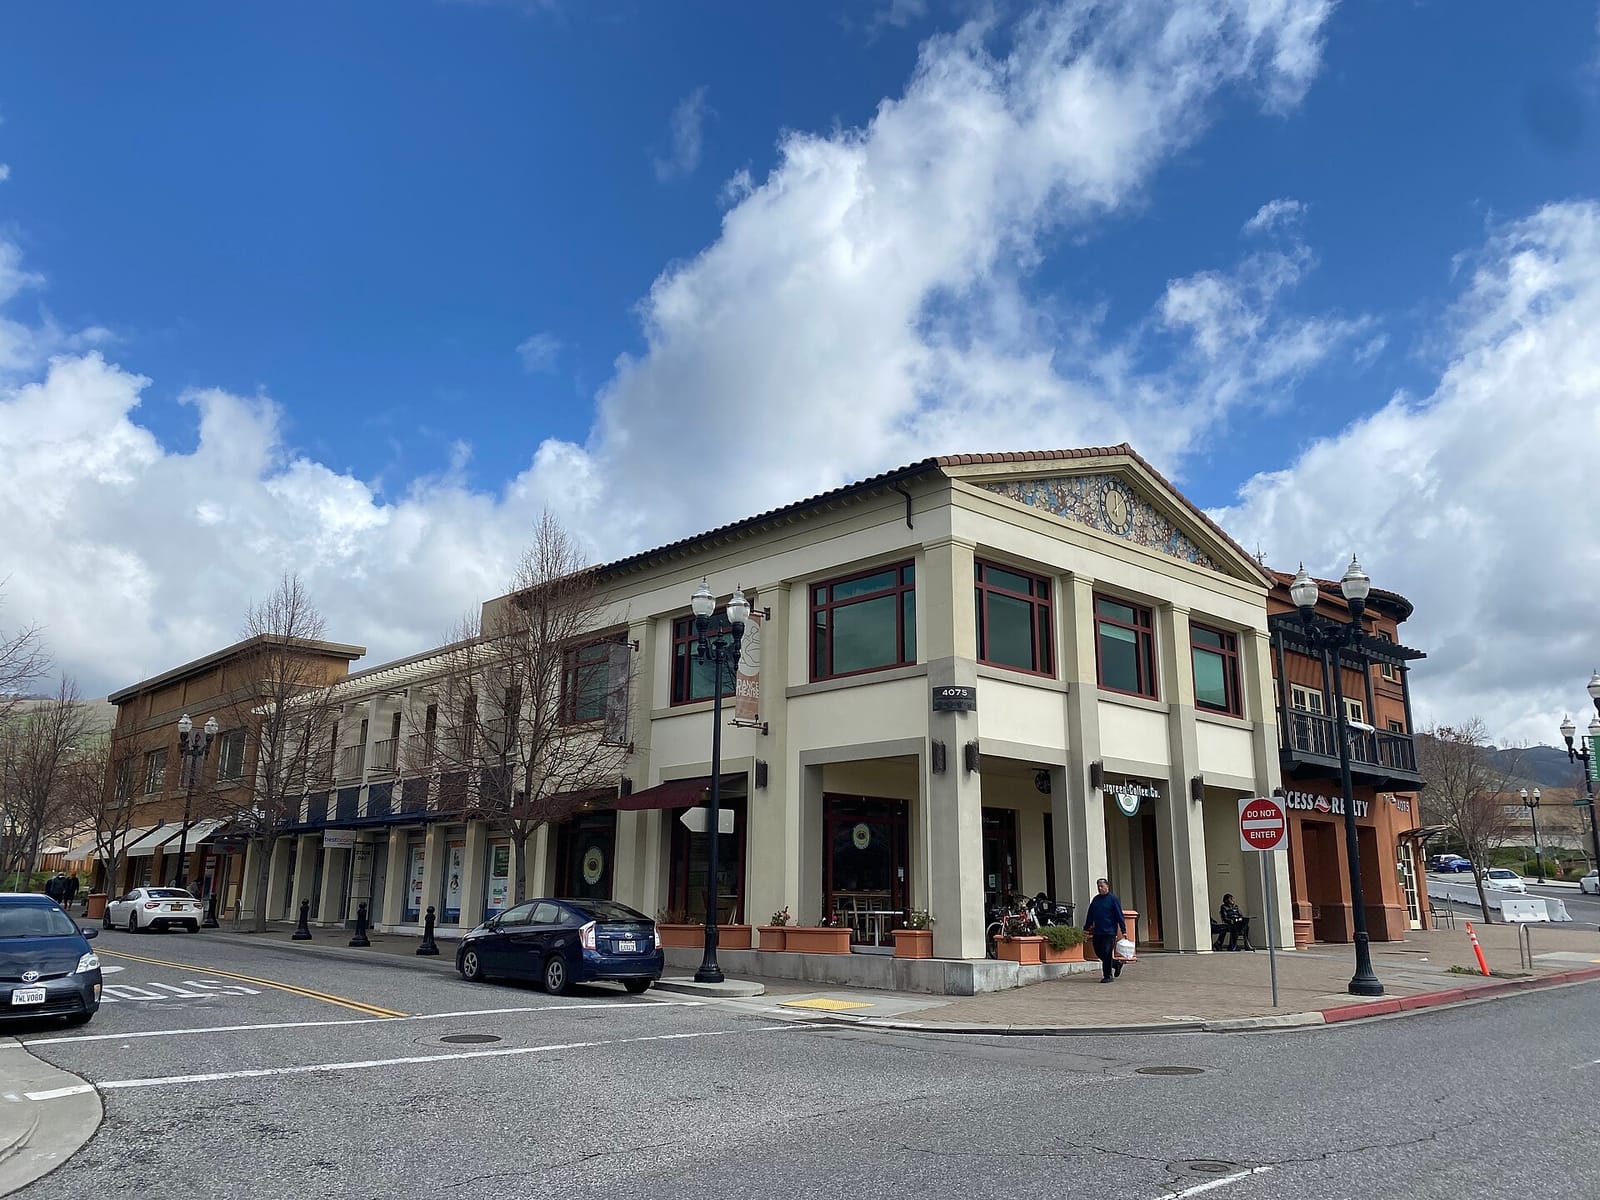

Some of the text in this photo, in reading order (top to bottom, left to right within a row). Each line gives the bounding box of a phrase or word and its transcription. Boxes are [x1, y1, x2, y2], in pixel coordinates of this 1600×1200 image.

[736, 679, 760, 690] DANCE
[736, 686, 760, 698] THEATRE
[942, 688, 968, 696] 4075
[1103, 783, 1127, 795] ergreen
[1285, 790, 1369, 818] CESS RELTY
[1247, 809, 1276, 818] DO NOT
[1250, 830, 1276, 839] ENTER
